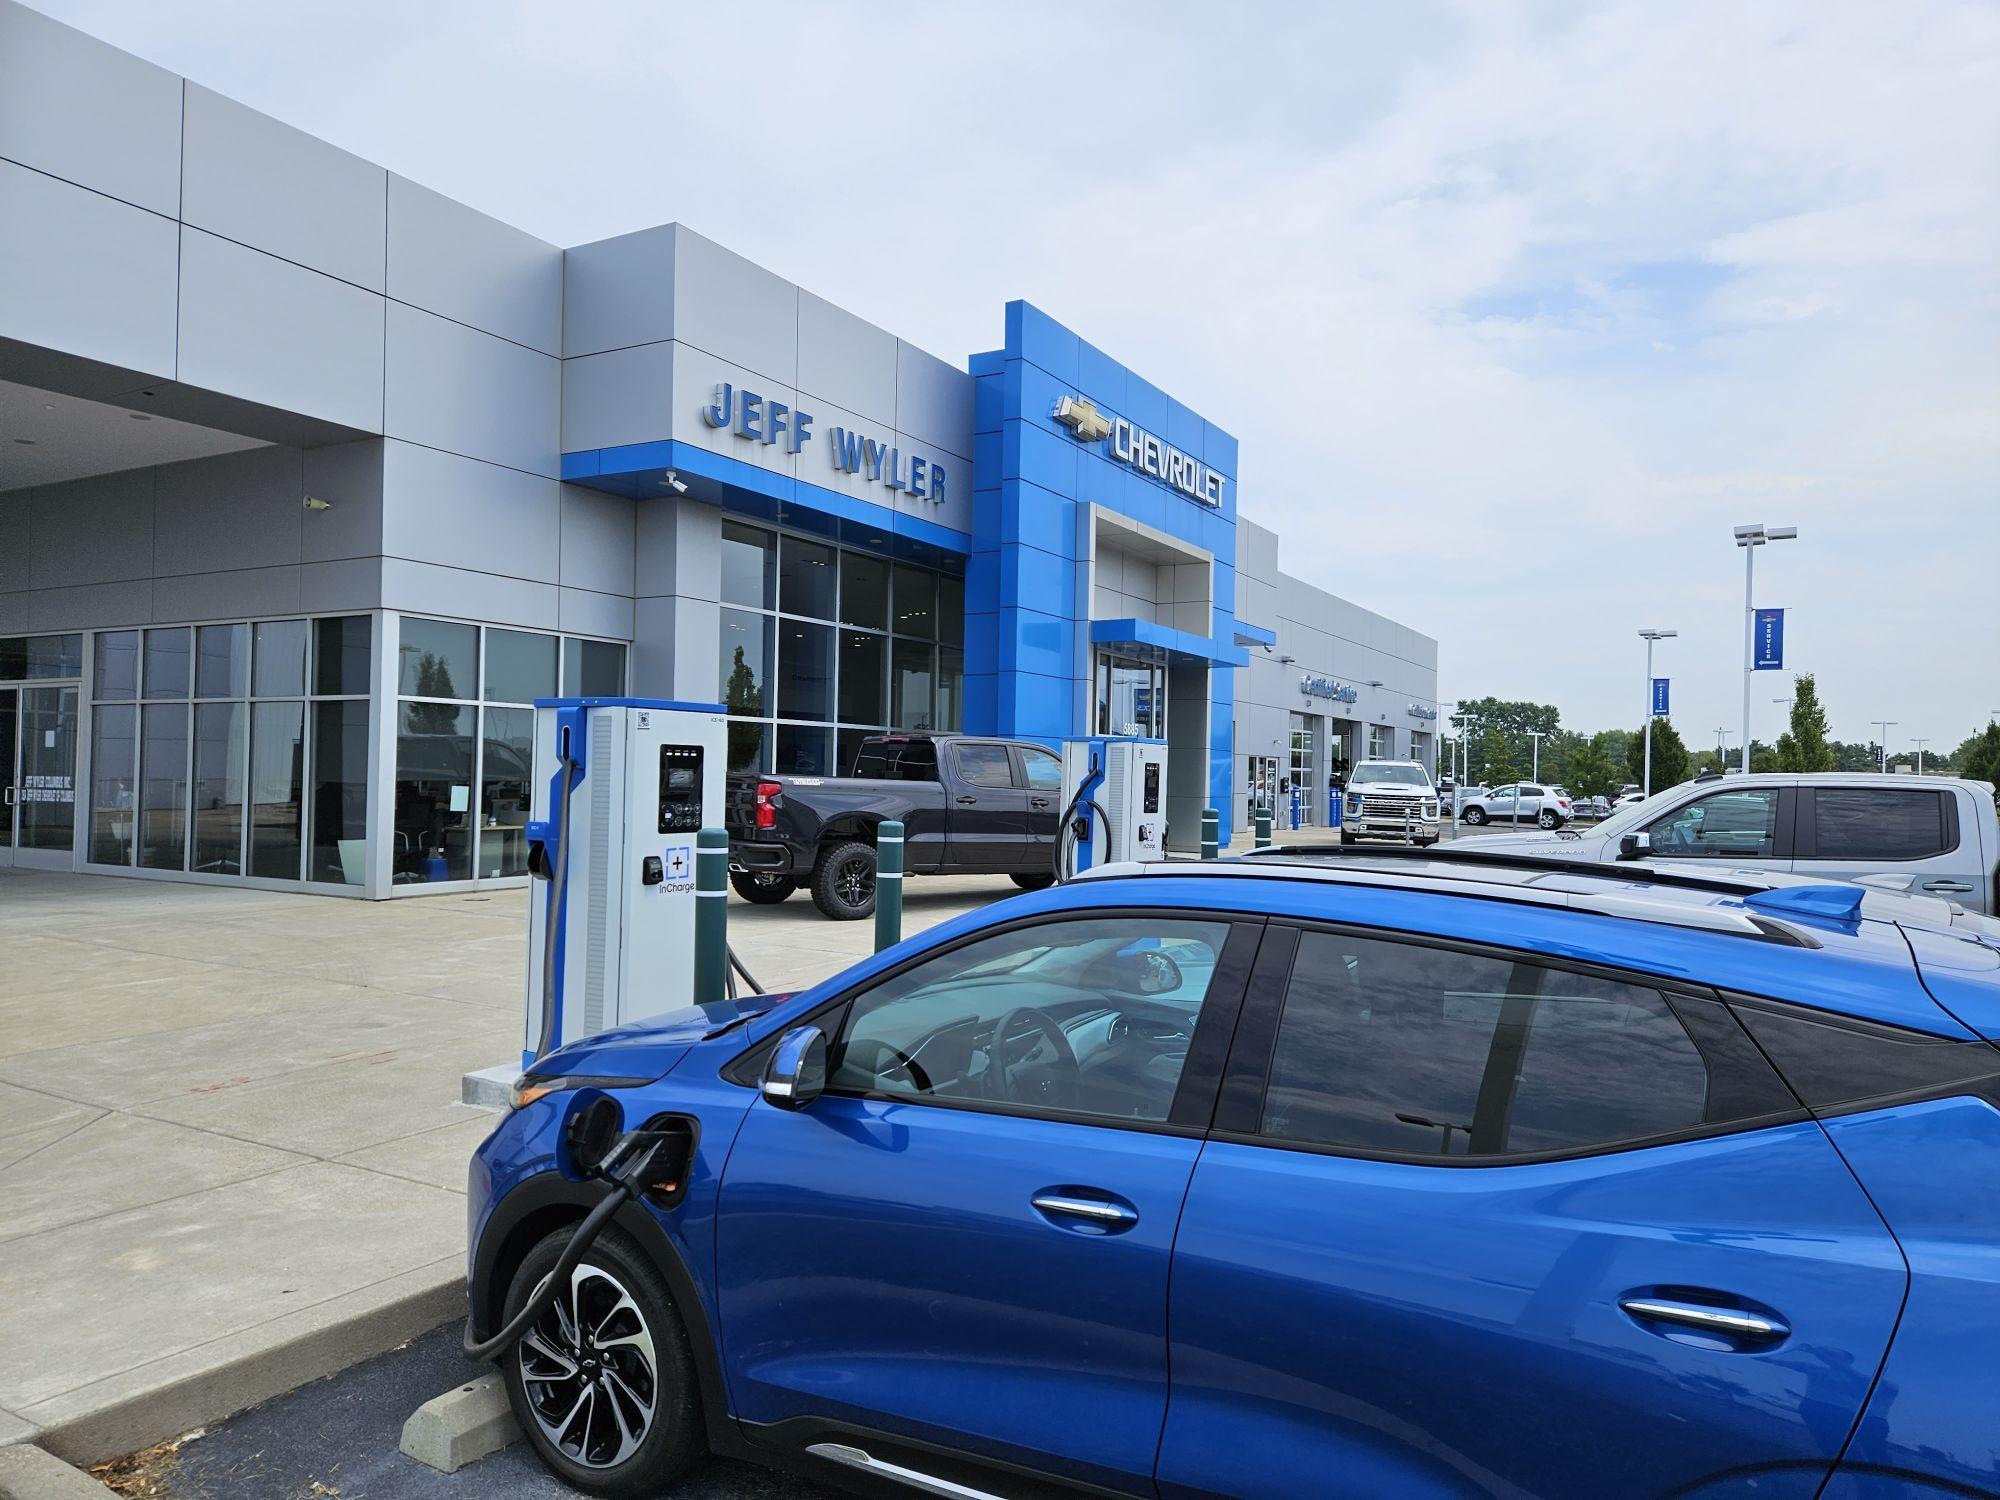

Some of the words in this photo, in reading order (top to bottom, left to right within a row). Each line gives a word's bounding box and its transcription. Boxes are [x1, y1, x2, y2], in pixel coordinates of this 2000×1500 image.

[703, 383, 813, 454] JEFF
[830, 427, 946, 504] WYLER
[1111, 417, 1225, 508] CHEVROLET
[660, 883, 695, 894] InCharge
